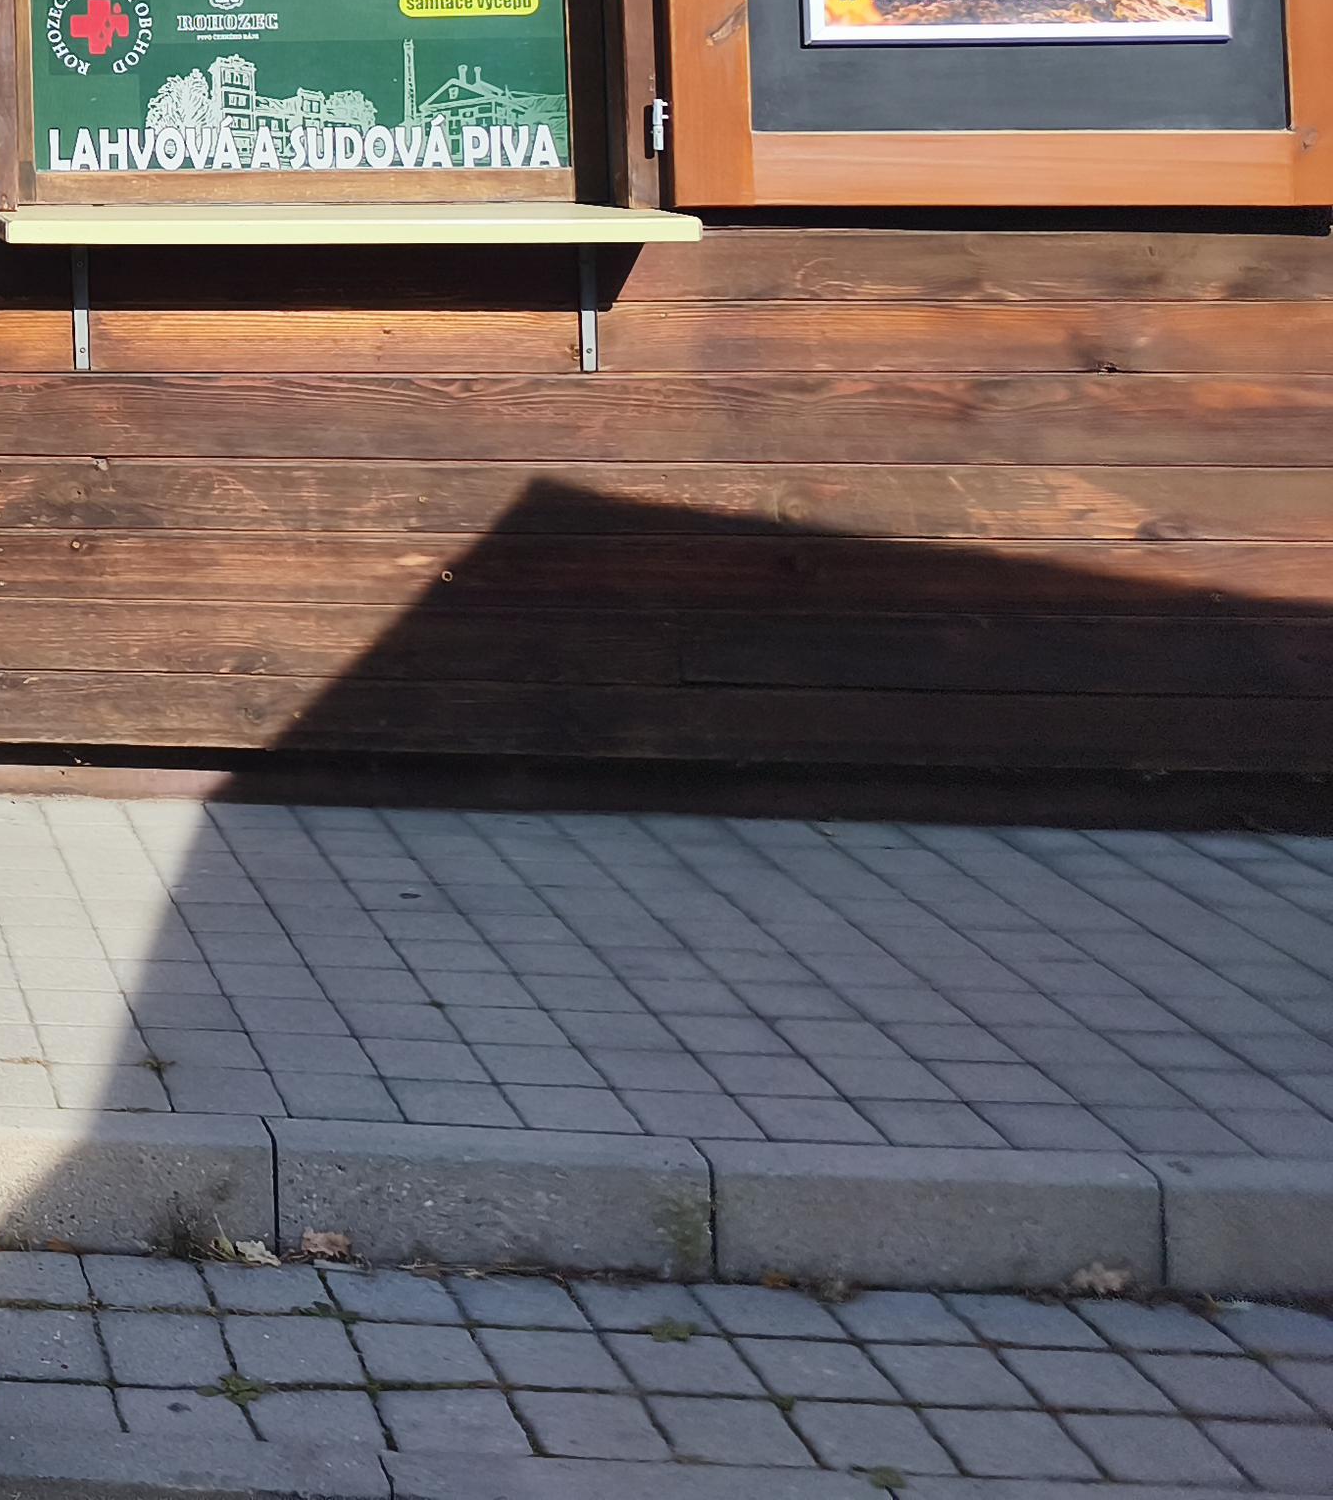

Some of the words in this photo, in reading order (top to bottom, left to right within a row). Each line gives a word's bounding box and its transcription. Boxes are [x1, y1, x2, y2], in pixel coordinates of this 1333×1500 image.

[113, 2, 153, 75] OBCHOD
[176, 13, 280, 32] ROHOZEC
[48, 114, 242, 171] LAHVOVÁ
[250, 126, 281, 170] A
[288, 113, 454, 169] SUDOVÁ
[461, 123, 562, 168] PIVA
